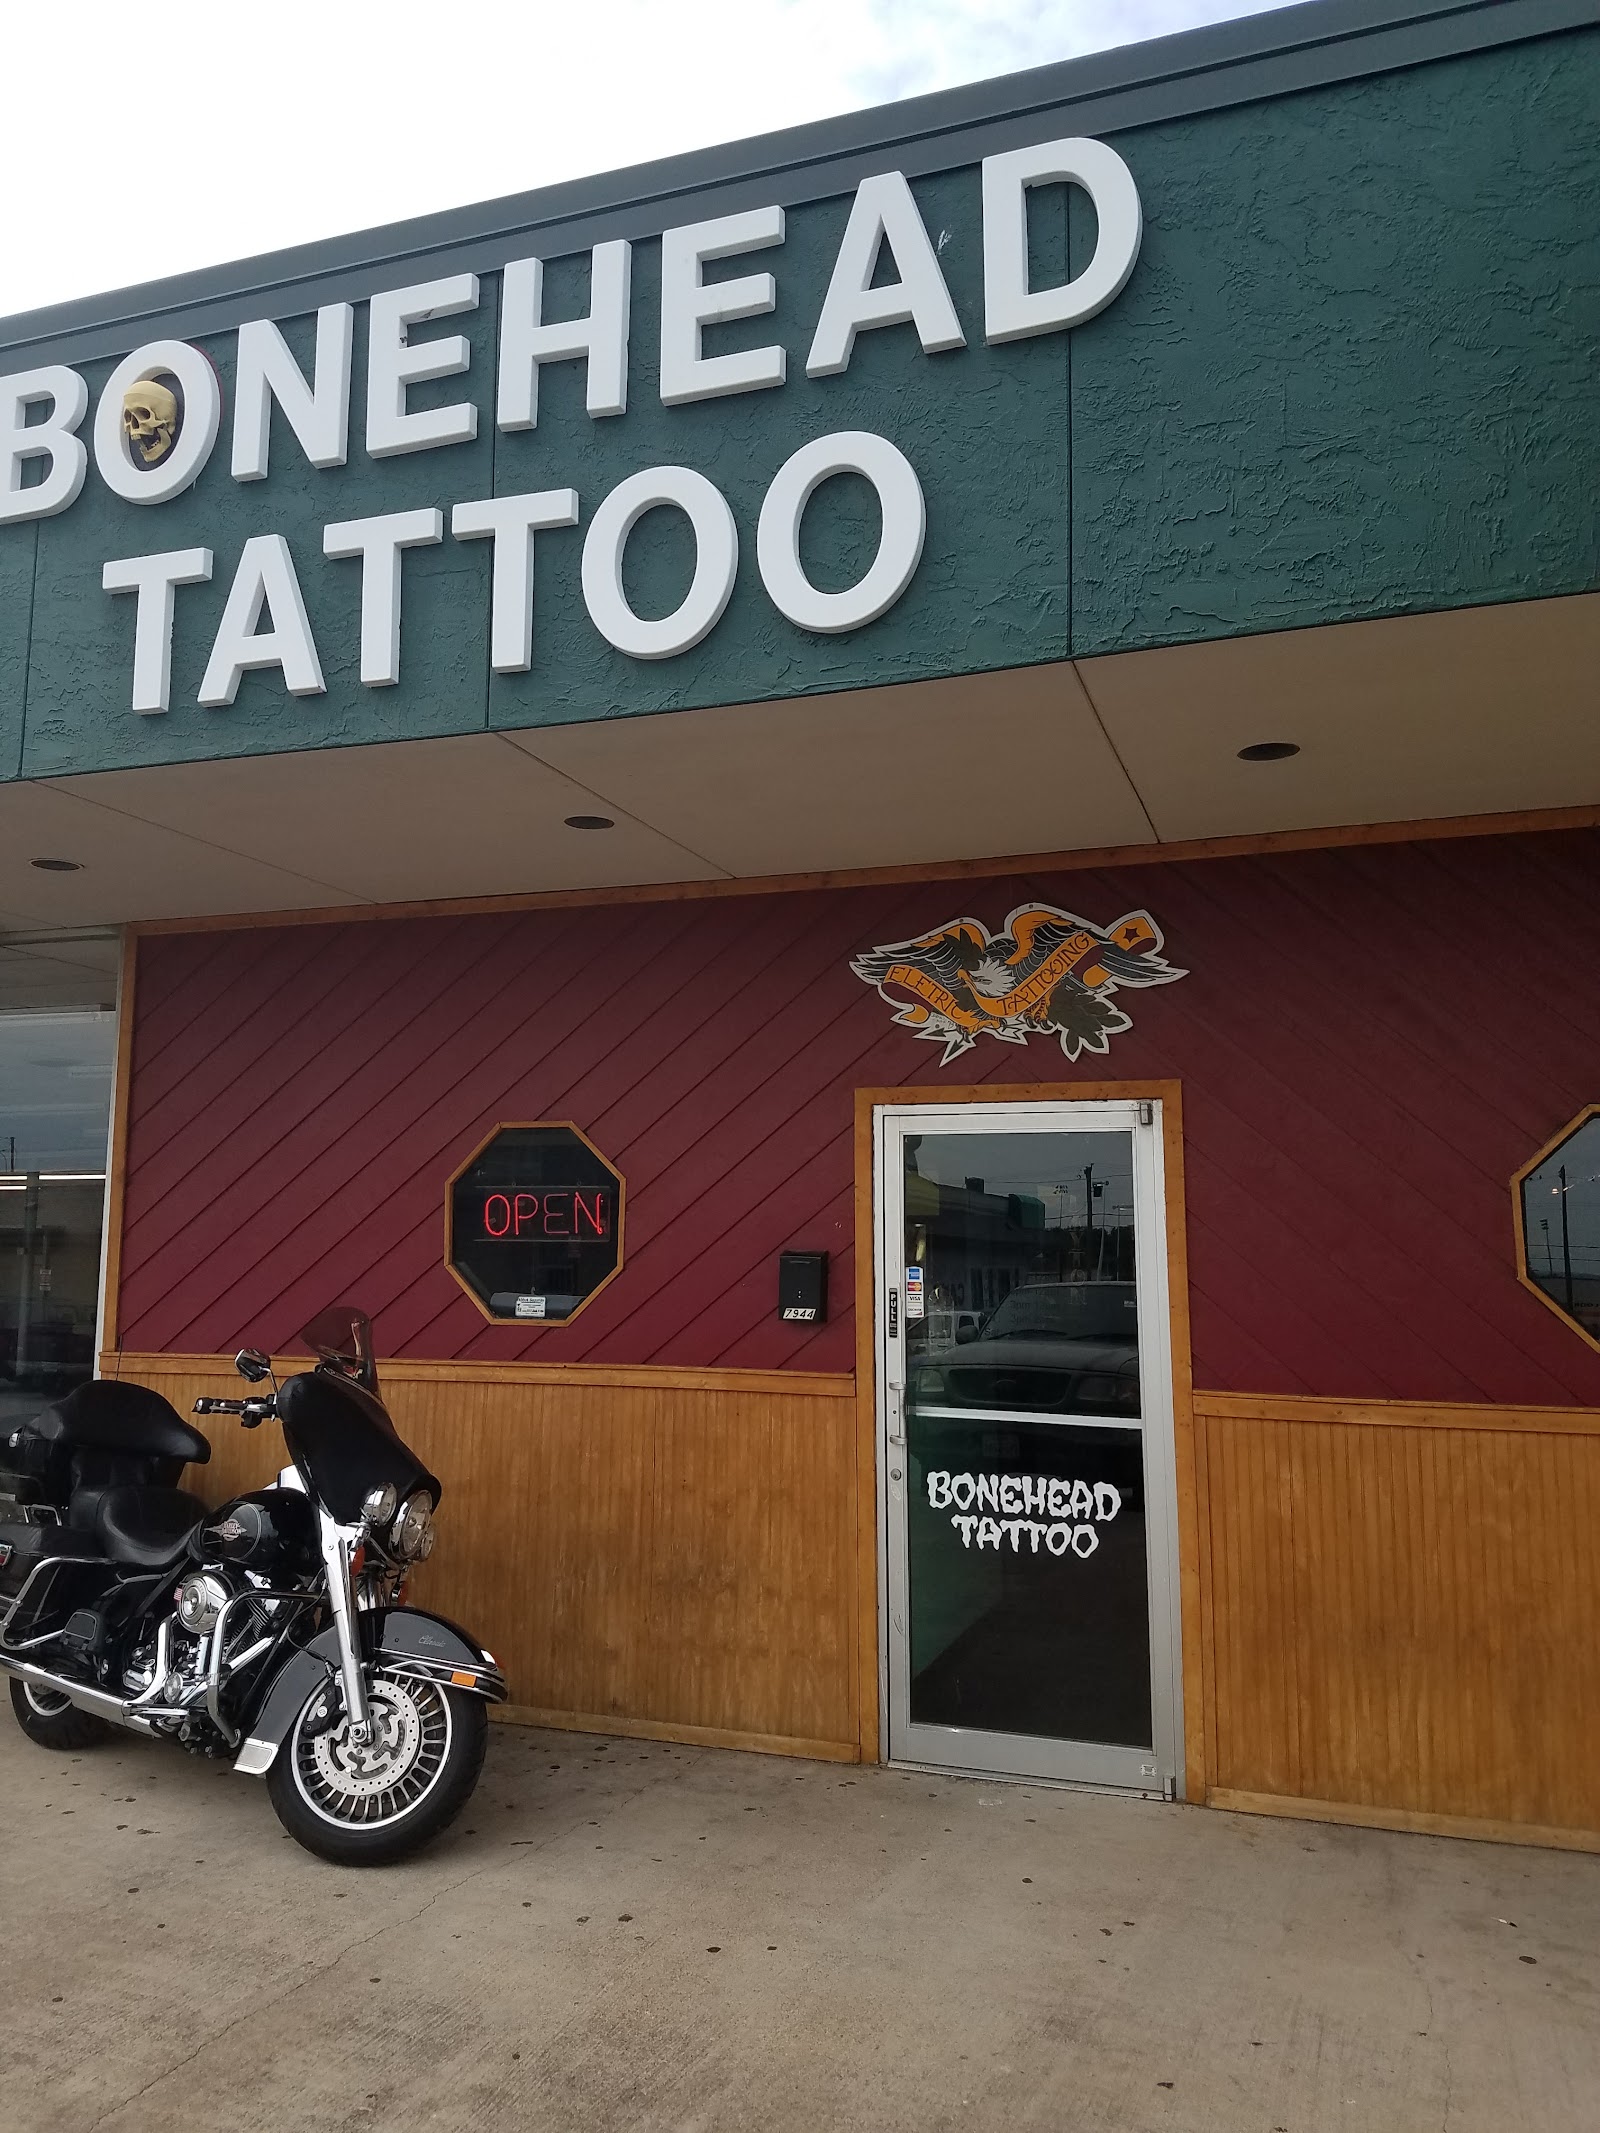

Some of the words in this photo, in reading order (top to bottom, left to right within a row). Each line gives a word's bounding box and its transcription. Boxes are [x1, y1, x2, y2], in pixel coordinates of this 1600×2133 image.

[0, 137, 1142, 525] BONEHEAD
[103, 431, 927, 715] TATTOO
[996, 931, 1090, 1016] TATTOOING
[484, 1191, 604, 1236] OPEN
[785, 1309, 815, 1319] 7944
[927, 1470, 1122, 1521] BONEHEAD
[951, 1514, 1099, 1558] TATTOO
